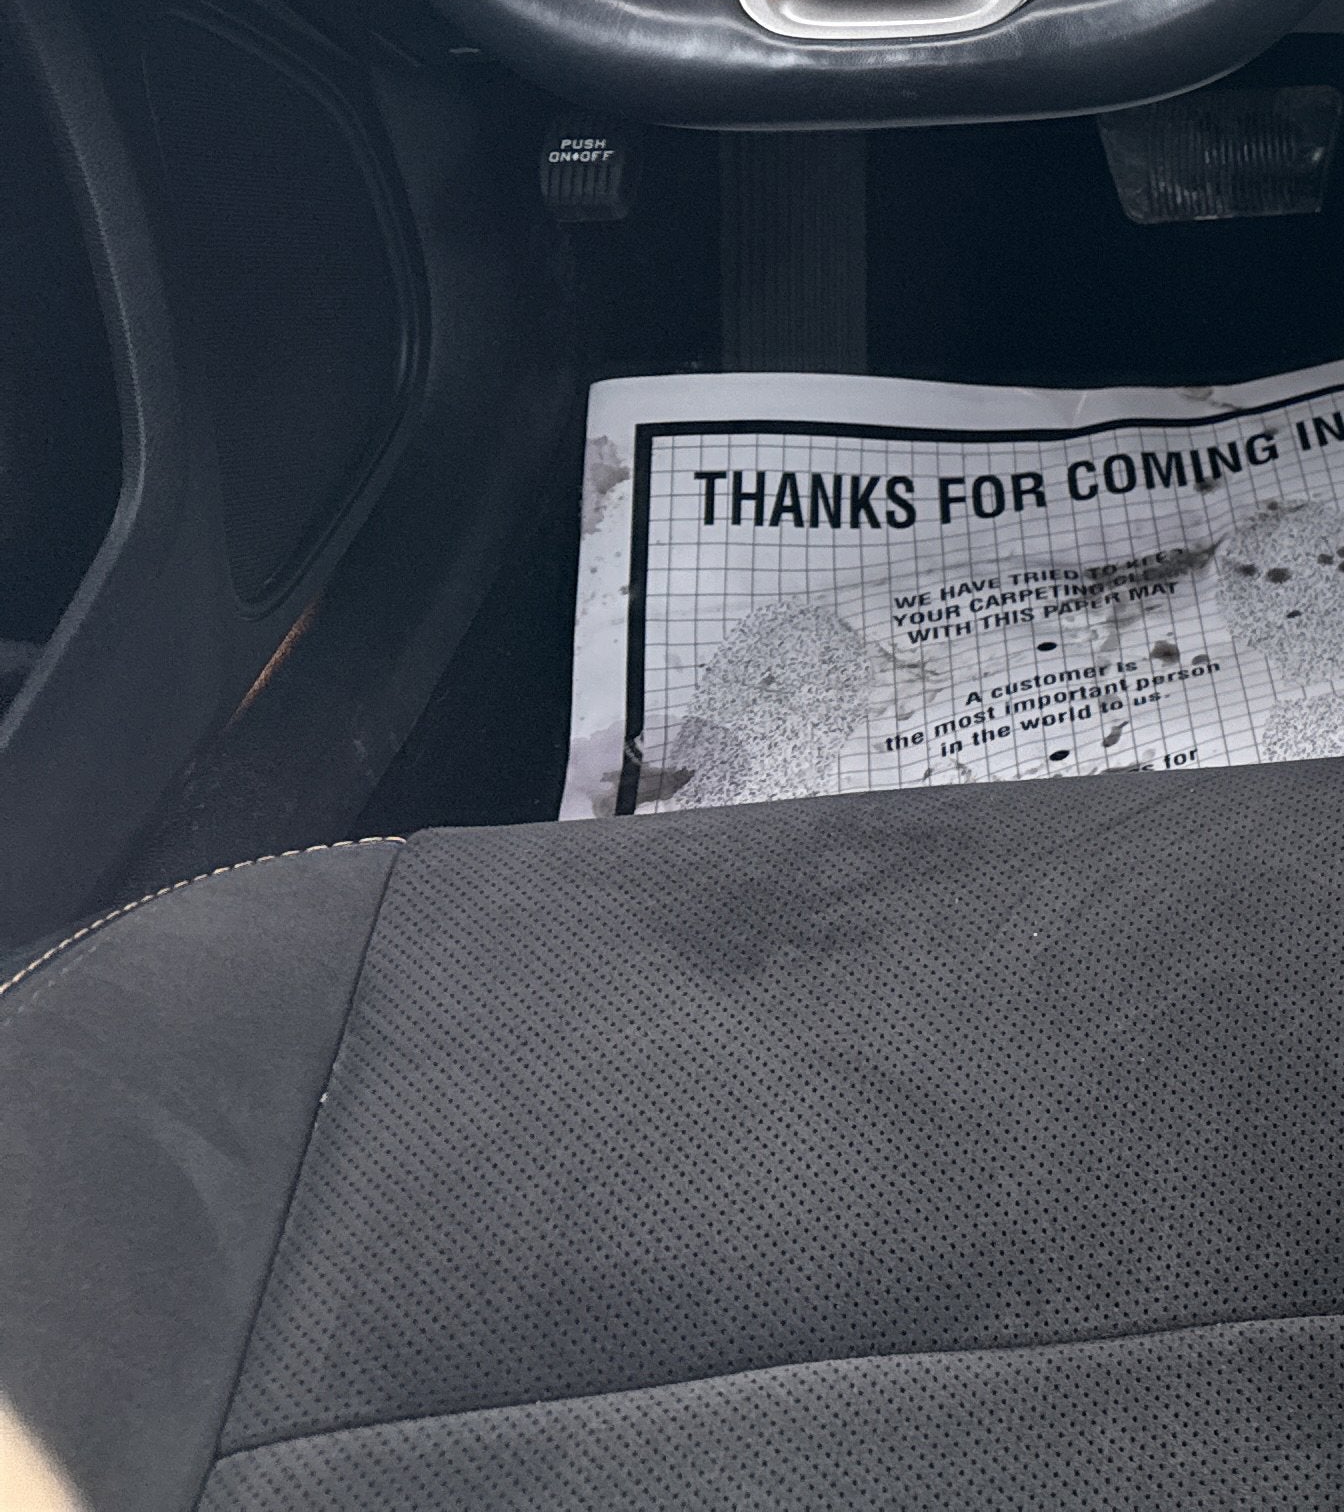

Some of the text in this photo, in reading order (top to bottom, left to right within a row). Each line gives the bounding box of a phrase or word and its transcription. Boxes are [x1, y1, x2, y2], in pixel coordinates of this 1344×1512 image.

[560, 138, 607, 150] PUSH
[693, 470, 918, 530] THANKS
[938, 471, 1048, 526] FOR
[1066, 432, 1280, 502] COMING
[892, 581, 1105, 628] YOUR CARPETING
[894, 591, 932, 610] WE
[940, 577, 1001, 603] HAVE
[1008, 568, 1080, 586] TRIED
[1087, 562, 1117, 580] TO
[906, 580, 1180, 645] WITH THIS PAPER MAT
[885, 661, 1221, 753] the most important person
[964, 659, 1139, 707] A customer is
[941, 695, 1124, 759] in the world to
[1163, 747, 1199, 770] for
